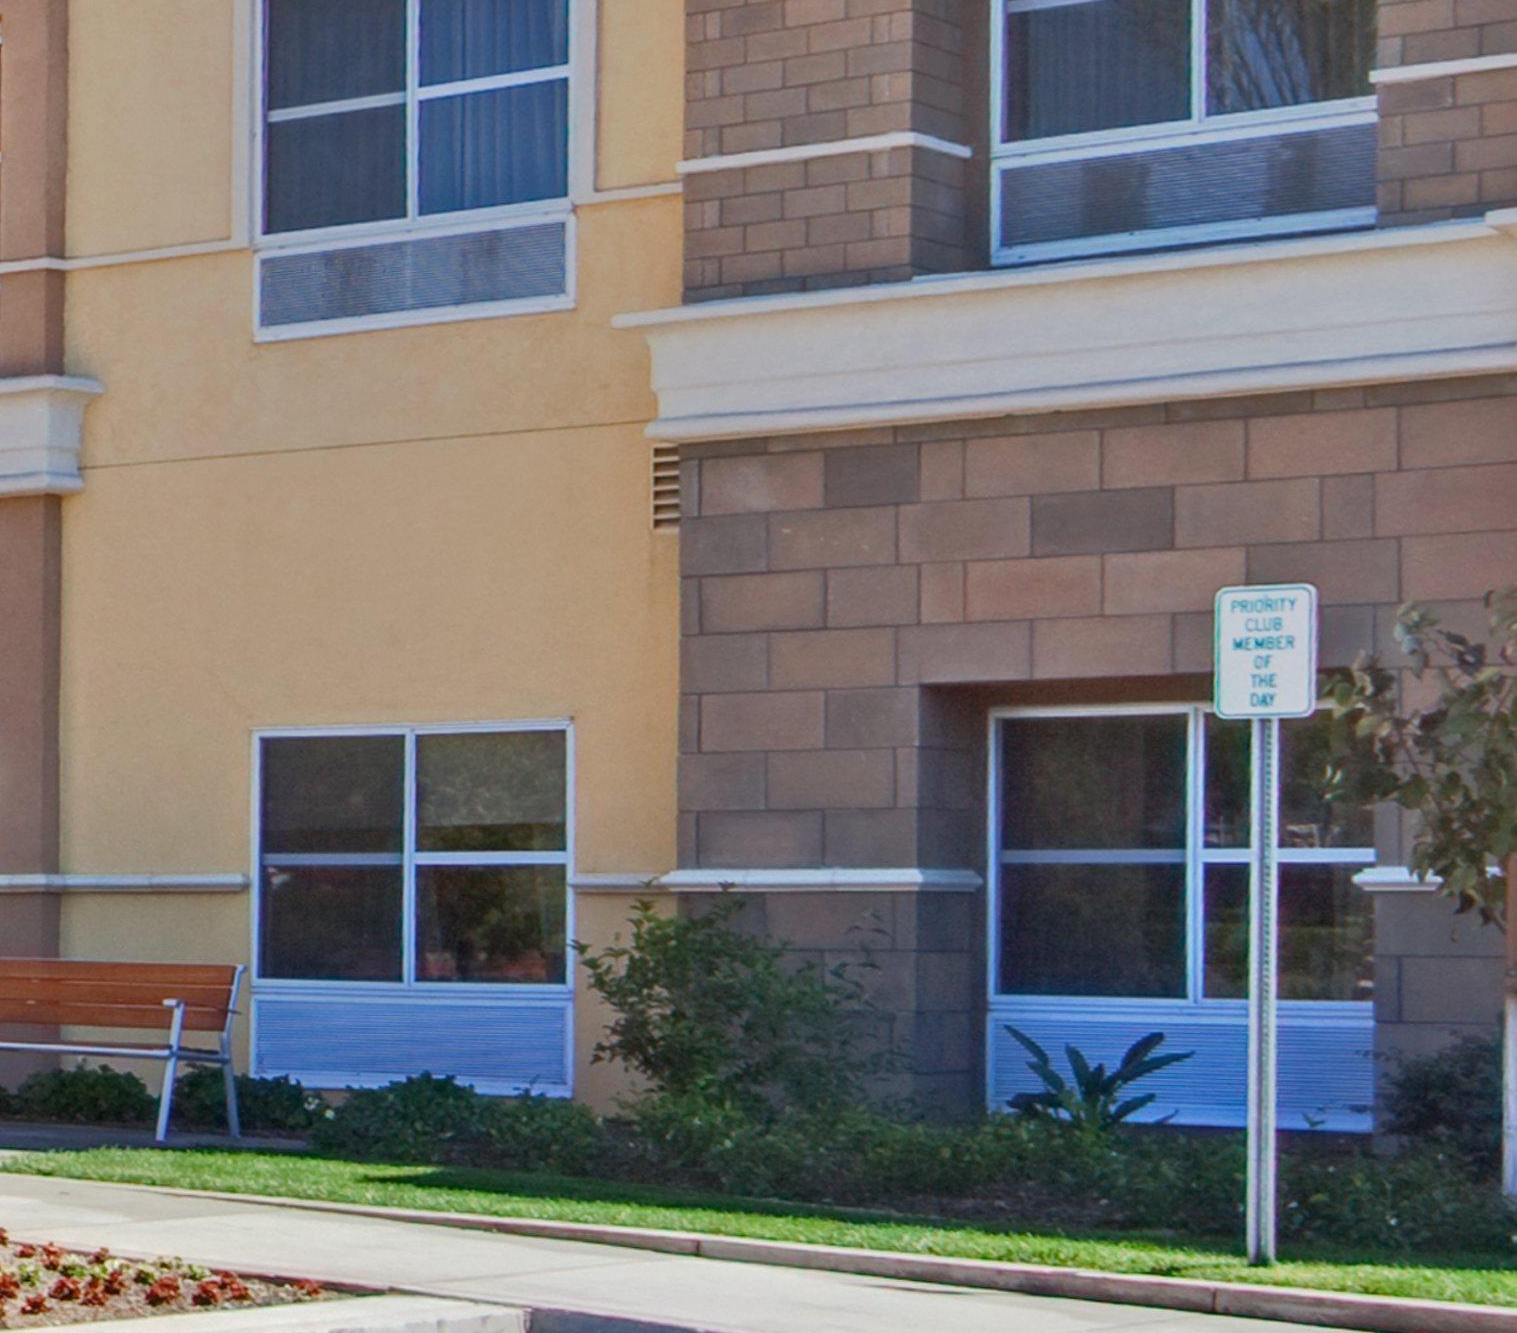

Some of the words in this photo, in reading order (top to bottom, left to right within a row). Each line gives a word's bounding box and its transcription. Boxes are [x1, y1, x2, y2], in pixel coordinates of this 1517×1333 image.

[1231, 597, 1297, 614] PRIORITY
[1245, 617, 1283, 632] CLUB
[1232, 636, 1295, 651] MEMBER
[1254, 655, 1273, 669] OF
[1252, 674, 1277, 688] THE
[1250, 693, 1276, 707] DAY
